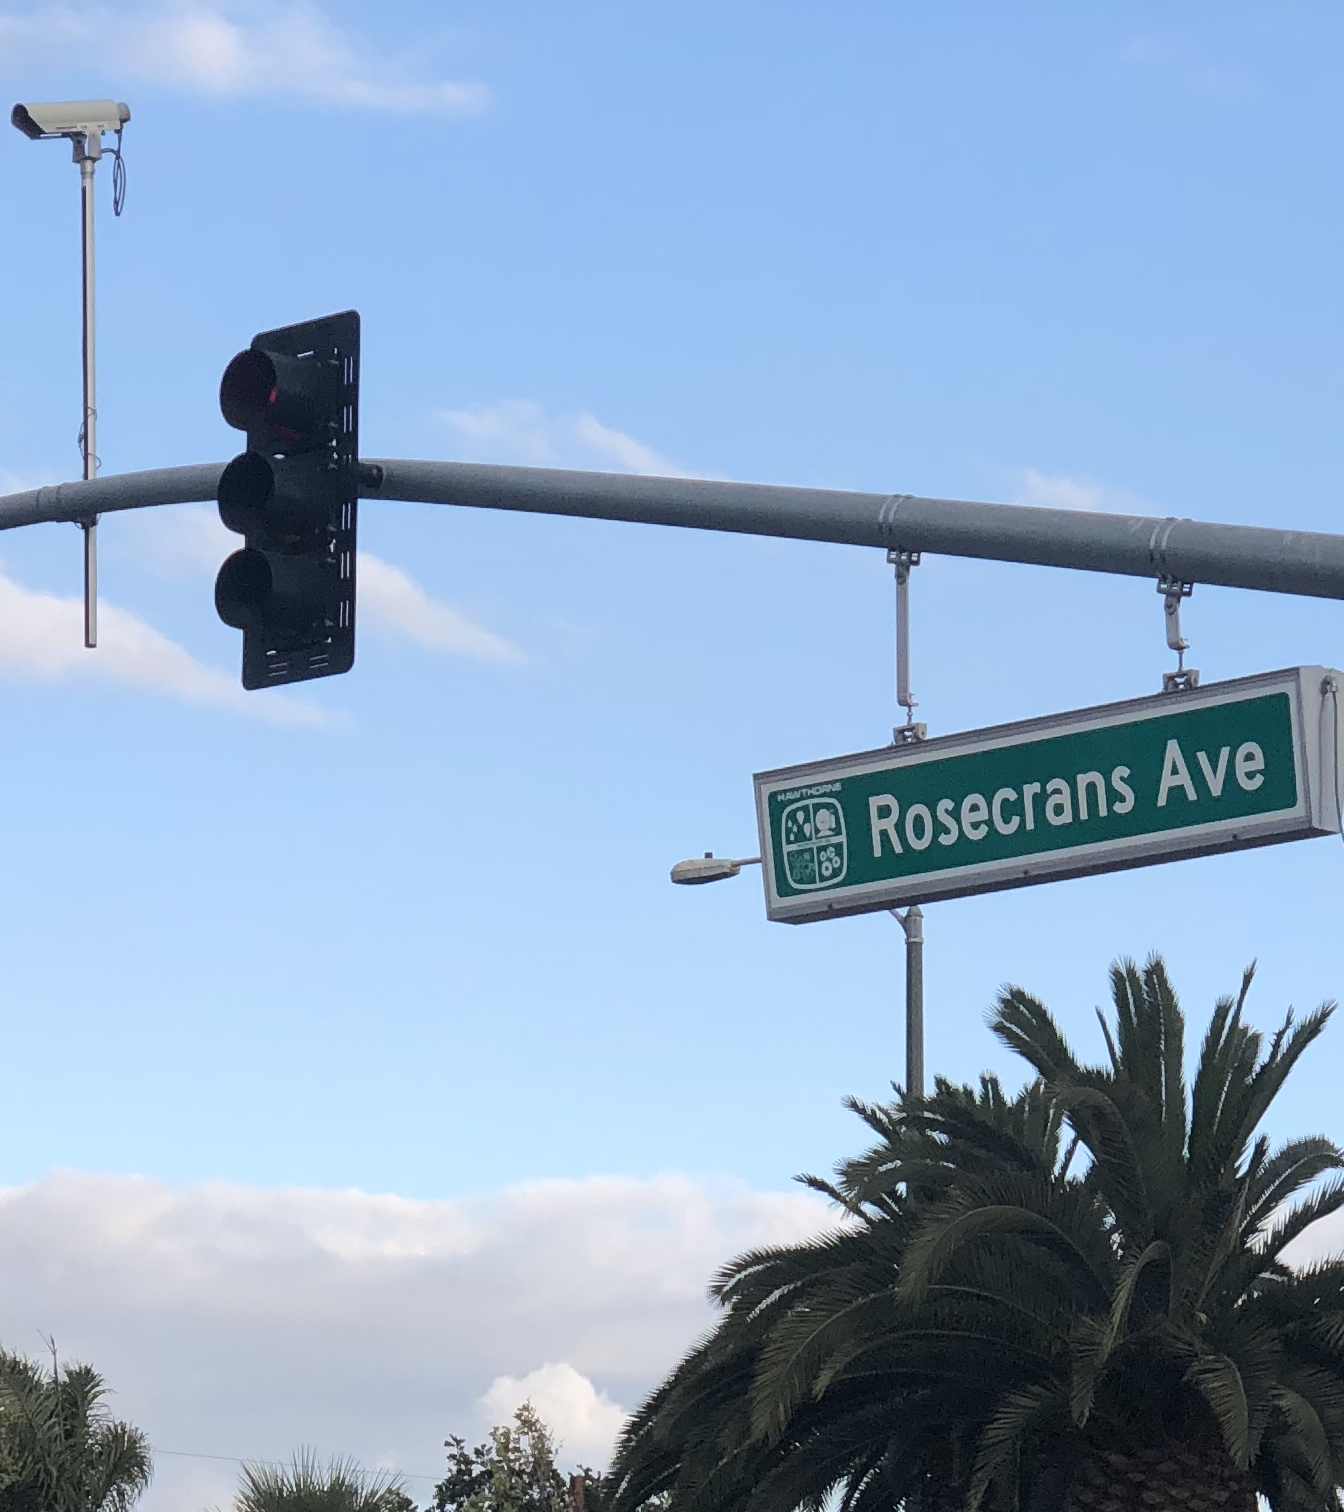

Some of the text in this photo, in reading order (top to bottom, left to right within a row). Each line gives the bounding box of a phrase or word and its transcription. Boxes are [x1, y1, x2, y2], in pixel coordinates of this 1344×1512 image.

[777, 782, 842, 802] HAWTHORNE
[868, 738, 1265, 858] Rosecrans Ave
